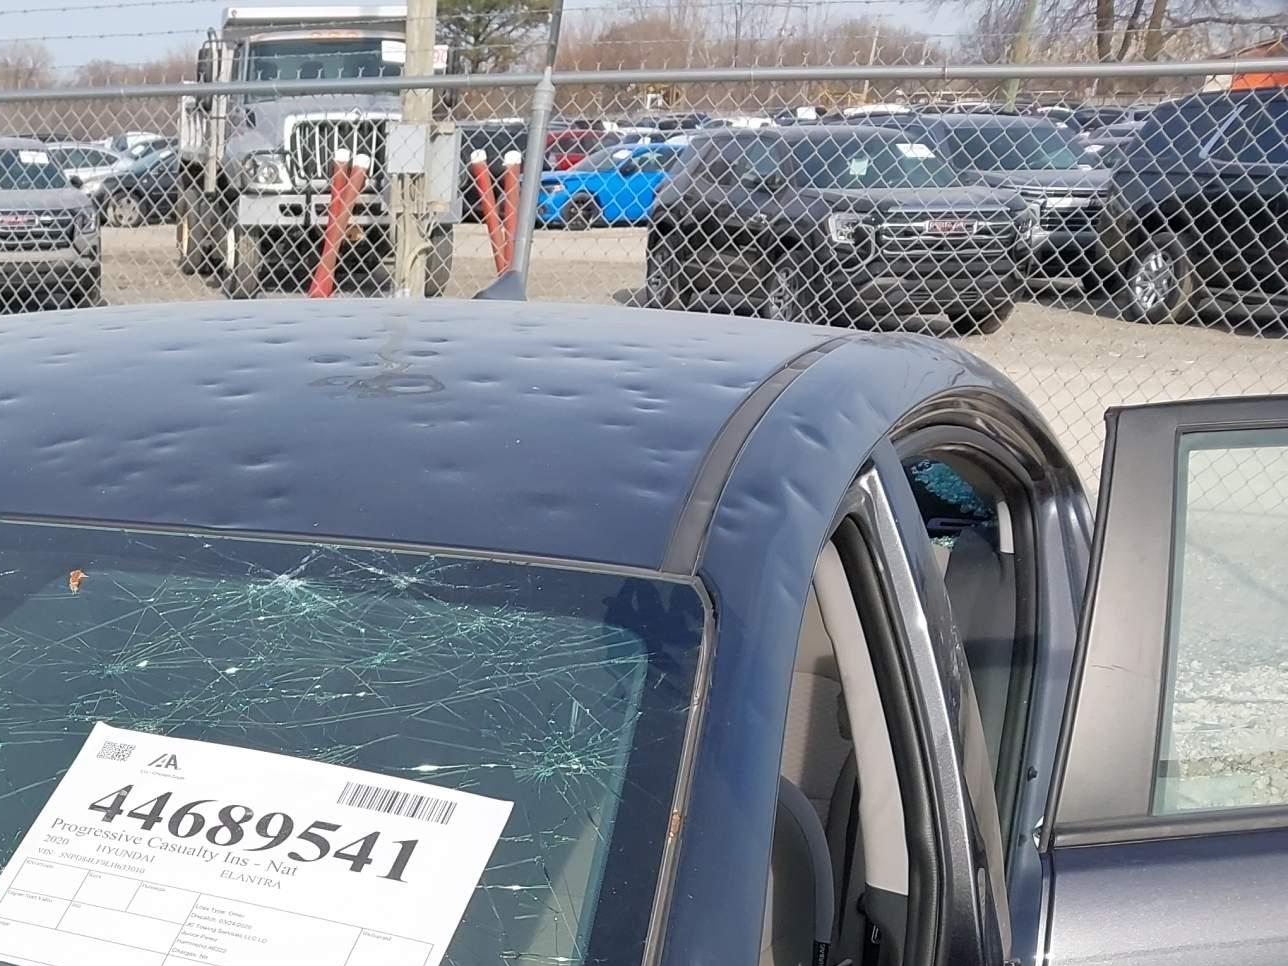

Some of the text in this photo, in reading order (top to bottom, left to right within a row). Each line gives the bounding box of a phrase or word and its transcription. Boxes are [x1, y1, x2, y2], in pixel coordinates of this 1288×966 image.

[43, 834, 281, 889] 2020 HYUNDAI ELANTRA
[51, 817, 143, 845] Progressive
[147, 833, 219, 863] Casualty
[224, 851, 250, 867] Ins
[266, 859, 299, 876] Nat
[88, 784, 420, 884] 44689541
